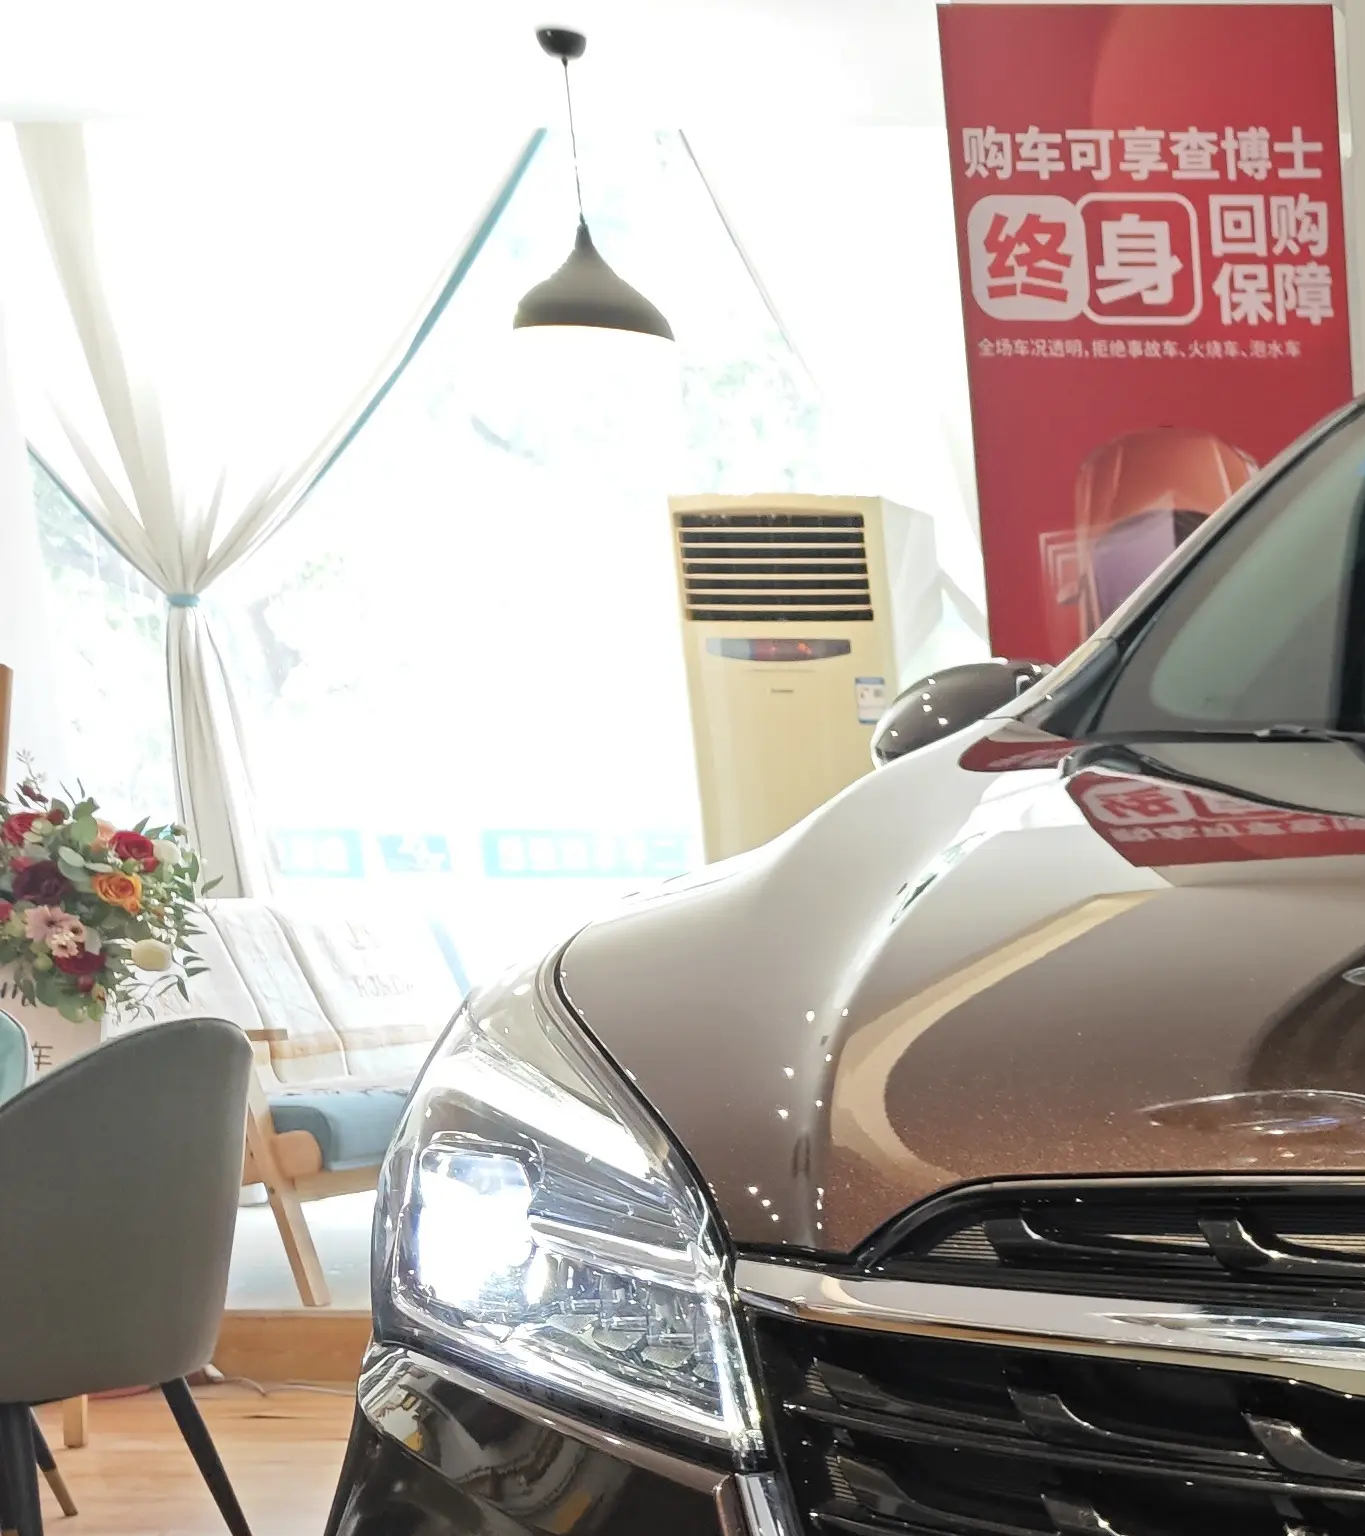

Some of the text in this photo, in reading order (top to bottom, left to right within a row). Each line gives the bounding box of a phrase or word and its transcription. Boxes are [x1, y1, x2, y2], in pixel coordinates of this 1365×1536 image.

[961, 125, 1324, 181] 购车可享查博士
[1208, 193, 1330, 257] 回购
[982, 213, 1183, 304] 终身
[1211, 261, 1335, 326] 保障
